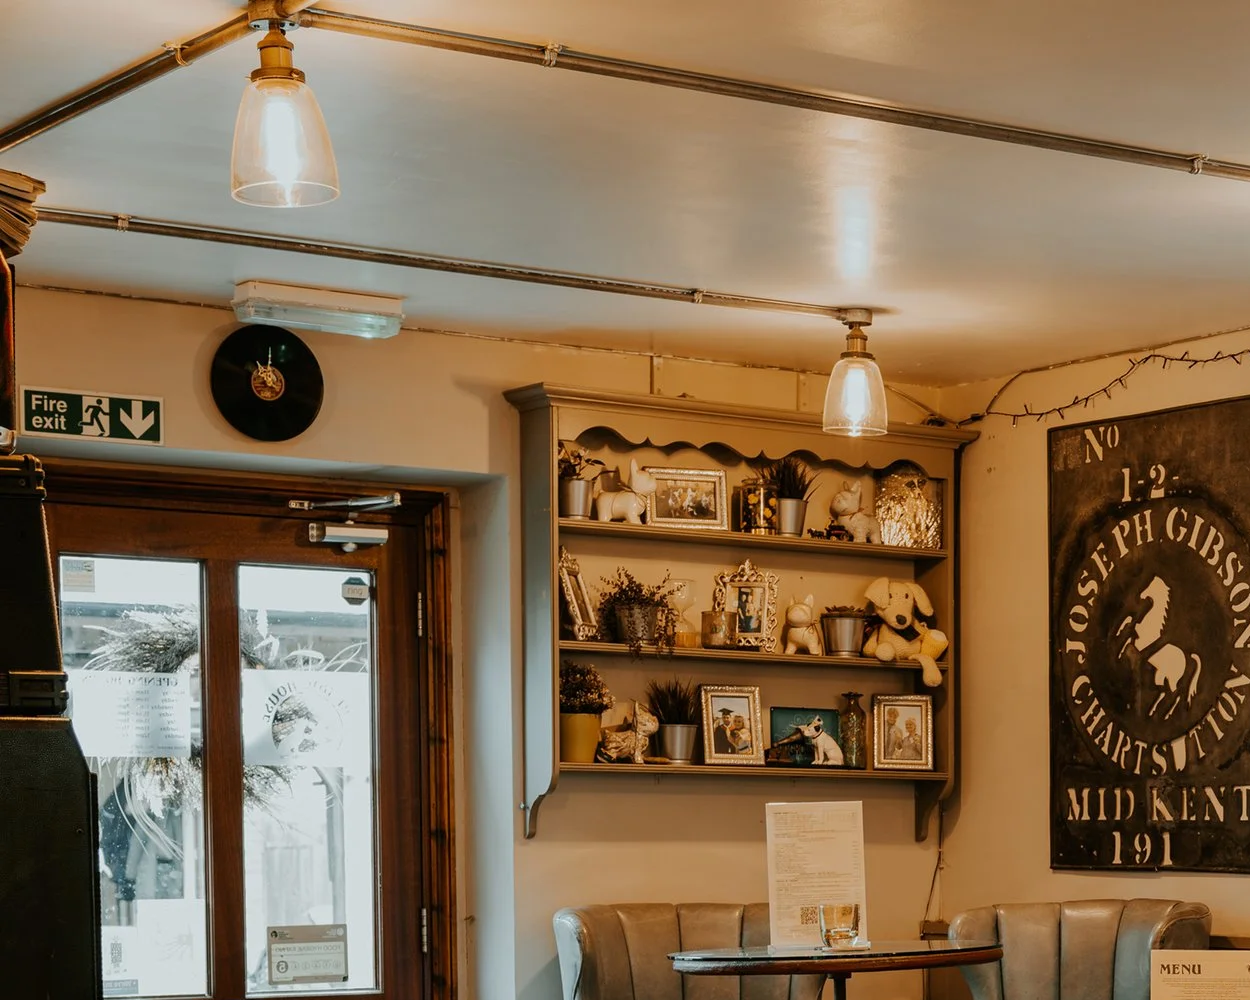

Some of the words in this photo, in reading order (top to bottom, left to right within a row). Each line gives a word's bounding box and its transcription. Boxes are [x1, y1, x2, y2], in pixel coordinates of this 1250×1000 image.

[31, 394, 68, 413] Fire
[31, 413, 67, 431] exit
[1064, 508, 1155, 665] JOSEPH
[1066, 786, 1135, 821] MID
[1111, 831, 1173, 866] 191
[1160, 963, 1202, 975] MENU
